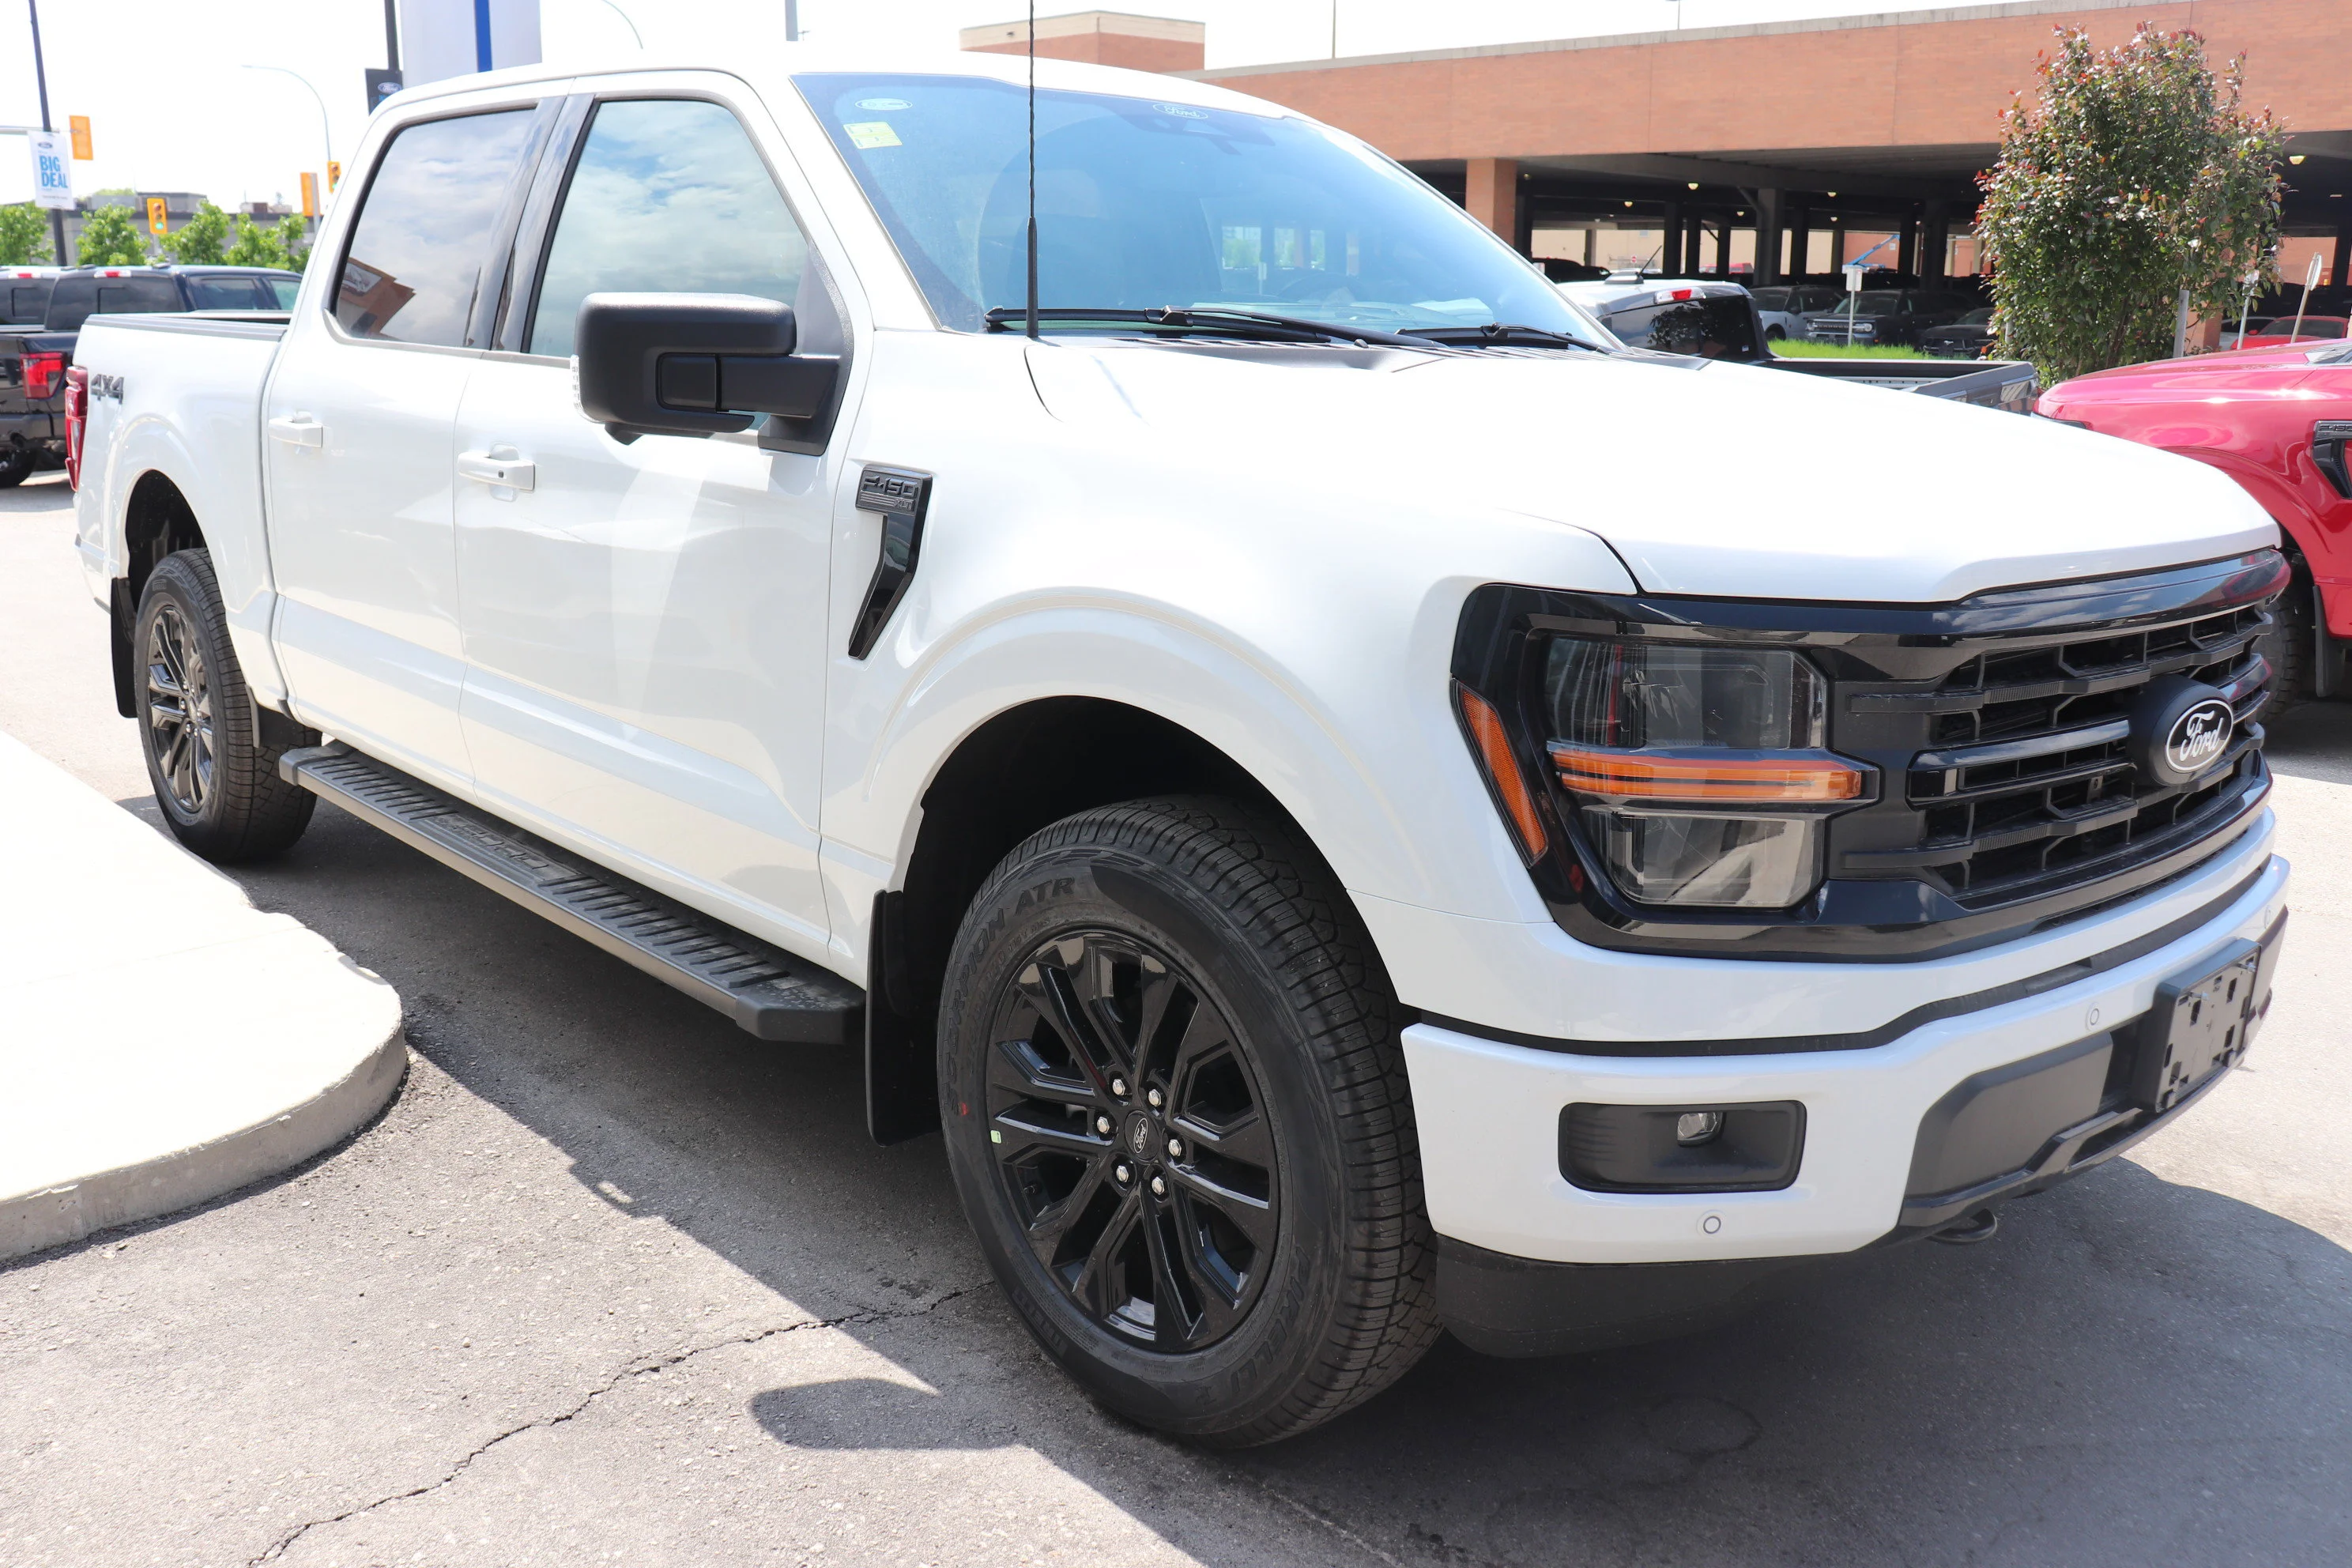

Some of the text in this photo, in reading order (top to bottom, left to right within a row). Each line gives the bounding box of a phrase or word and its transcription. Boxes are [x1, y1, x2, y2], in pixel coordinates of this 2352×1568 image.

[39, 155, 60, 172] BIG
[41, 172, 68, 189] DEAL
[863, 476, 919, 499] F-150
[893, 497, 915, 511] XLT
[2179, 710, 2224, 762] Ford
[1015, 876, 1076, 917] ATR
[1135, 1123, 1147, 1149] Ford
[1230, 1245, 1310, 1393] PIRELLI
